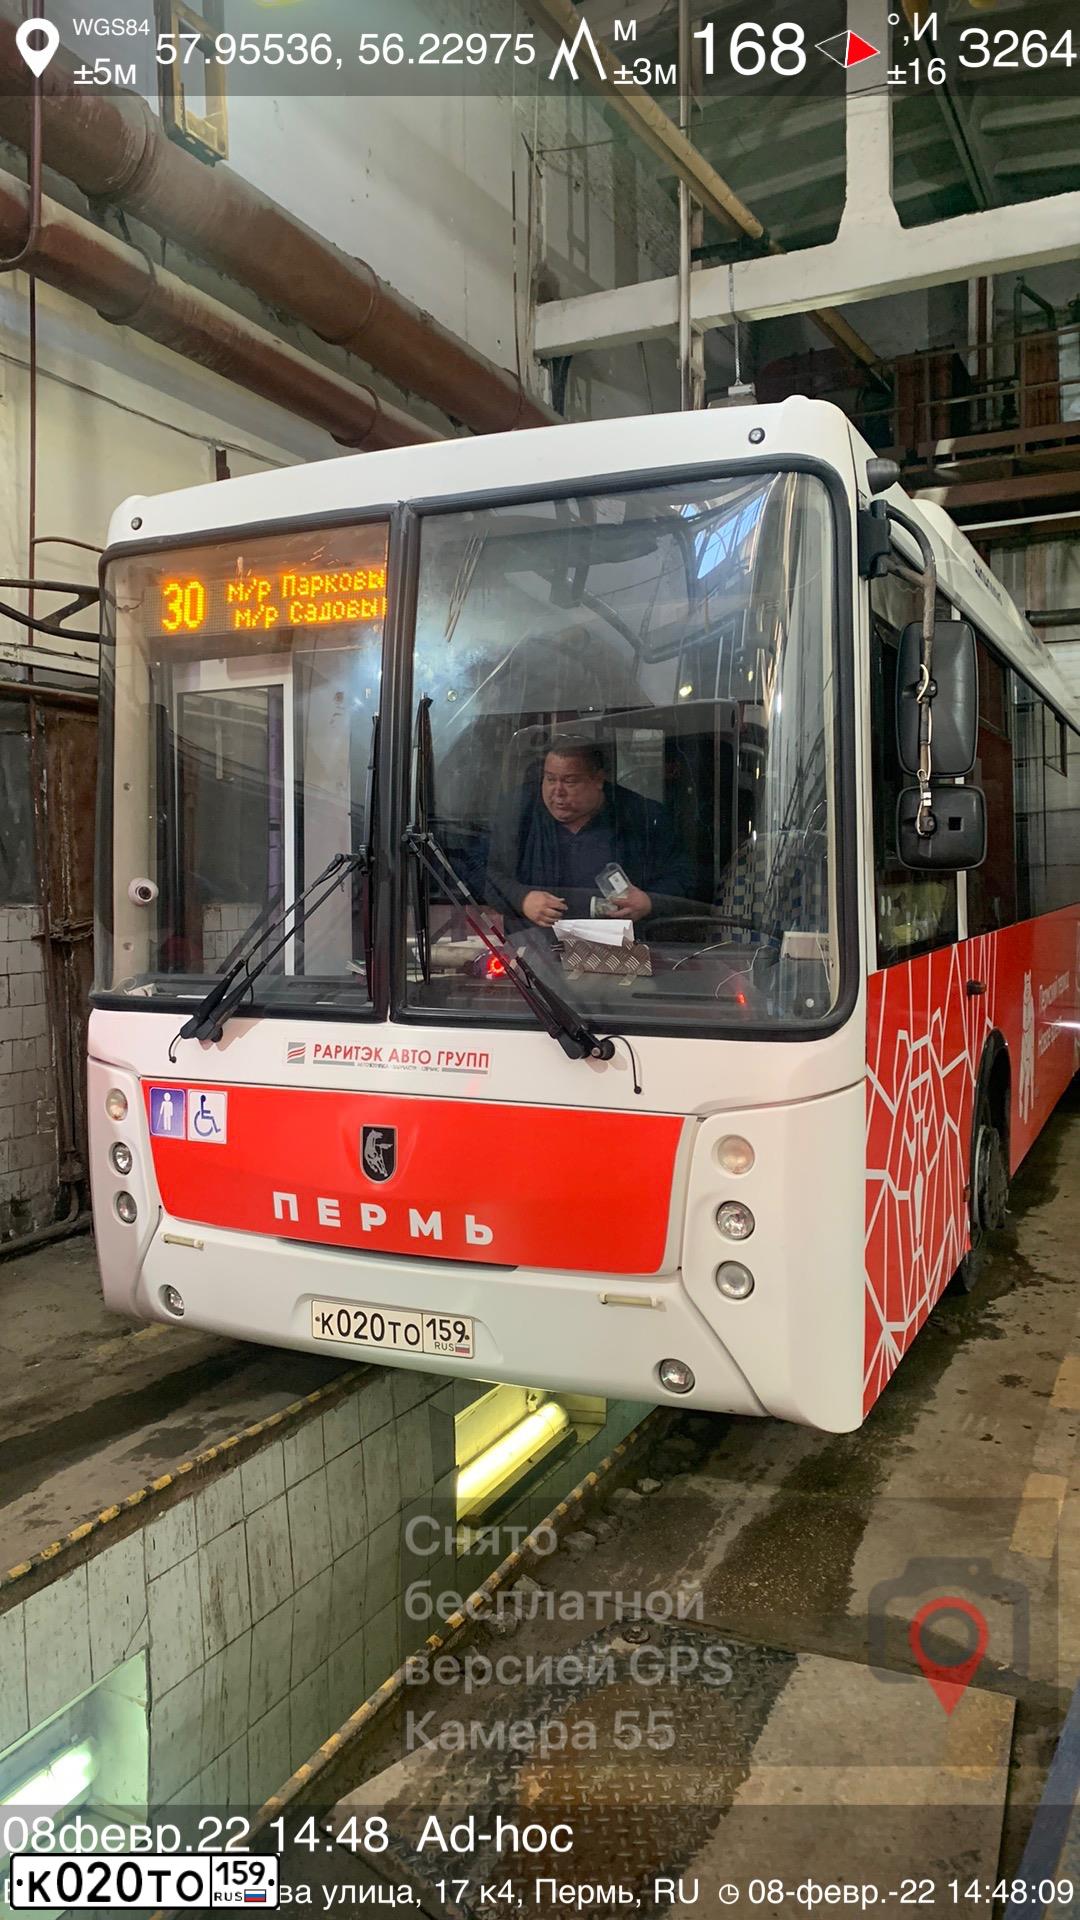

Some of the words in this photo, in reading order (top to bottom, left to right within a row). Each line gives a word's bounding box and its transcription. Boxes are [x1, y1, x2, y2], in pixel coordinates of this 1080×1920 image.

[161, 580, 207, 632] 30
[313, 1043, 383, 1063] РАРИТЭК
[388, 1049, 432, 1066] АВТО
[436, 1051, 490, 1069] ГРУПП
[272, 1190, 494, 1247] ПЕРМЬ
[321, 1309, 421, 1347] К020ТО
[425, 1317, 467, 1344] 159
[434, 1341, 455, 1352] RUS
